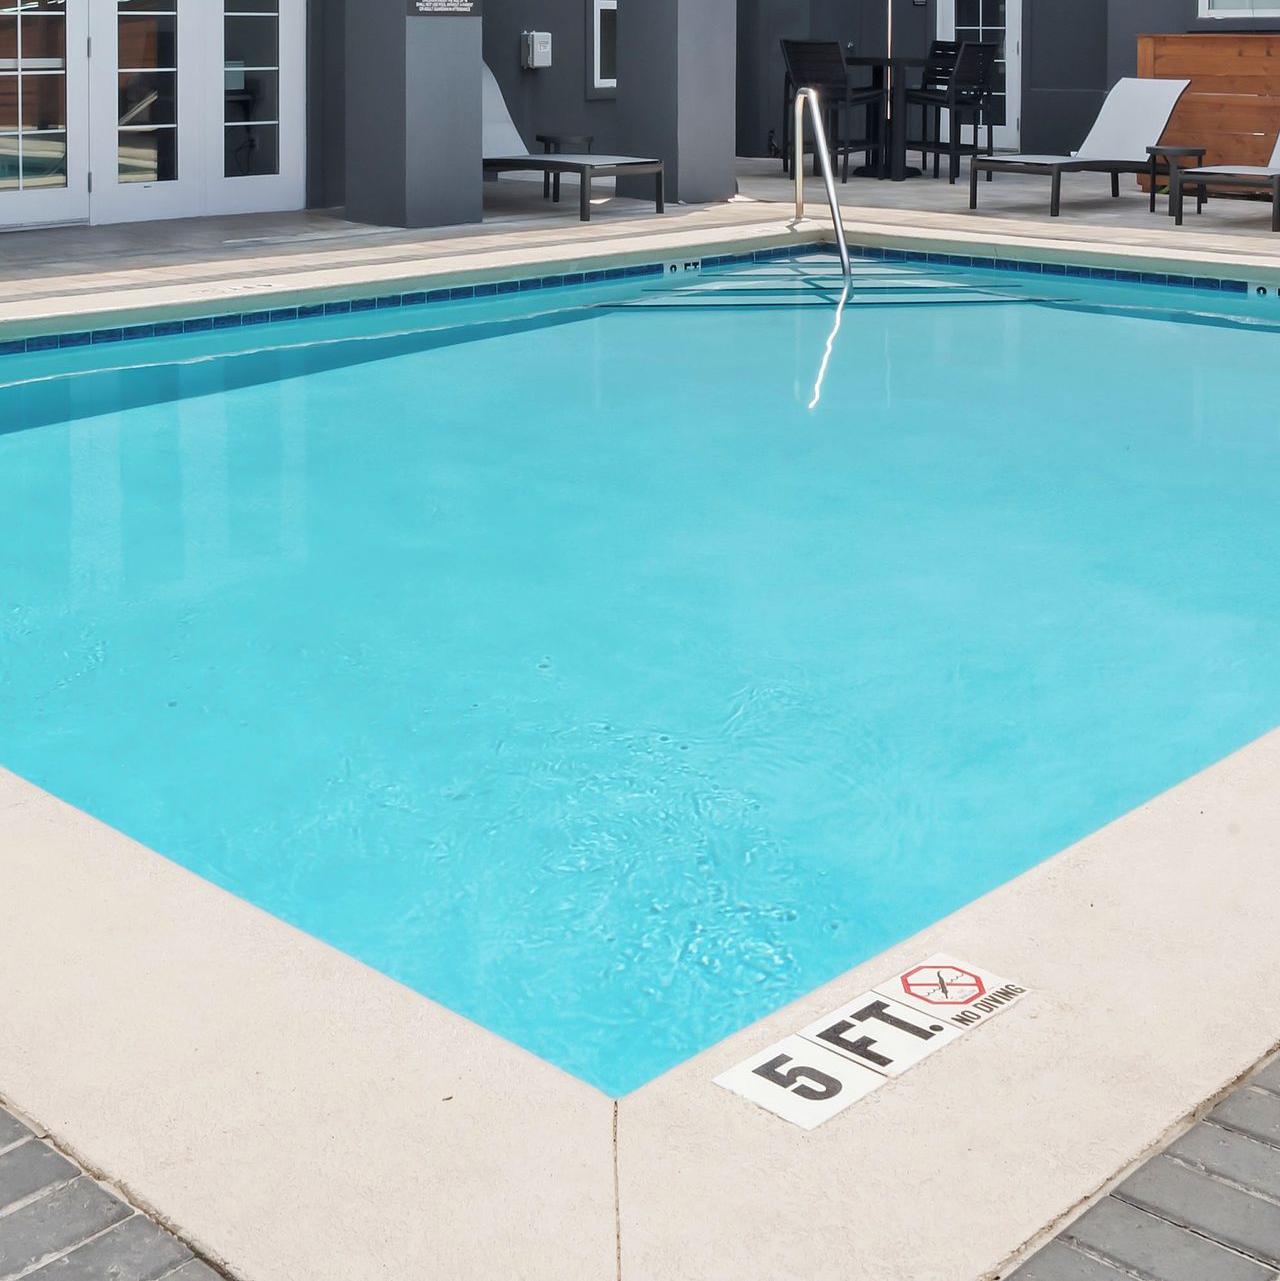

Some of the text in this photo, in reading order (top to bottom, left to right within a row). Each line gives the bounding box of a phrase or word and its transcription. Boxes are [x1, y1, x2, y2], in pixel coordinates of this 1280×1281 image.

[951, 984, 1027, 1027] NO DIVING
[751, 999, 945, 1101] 5 FT.
